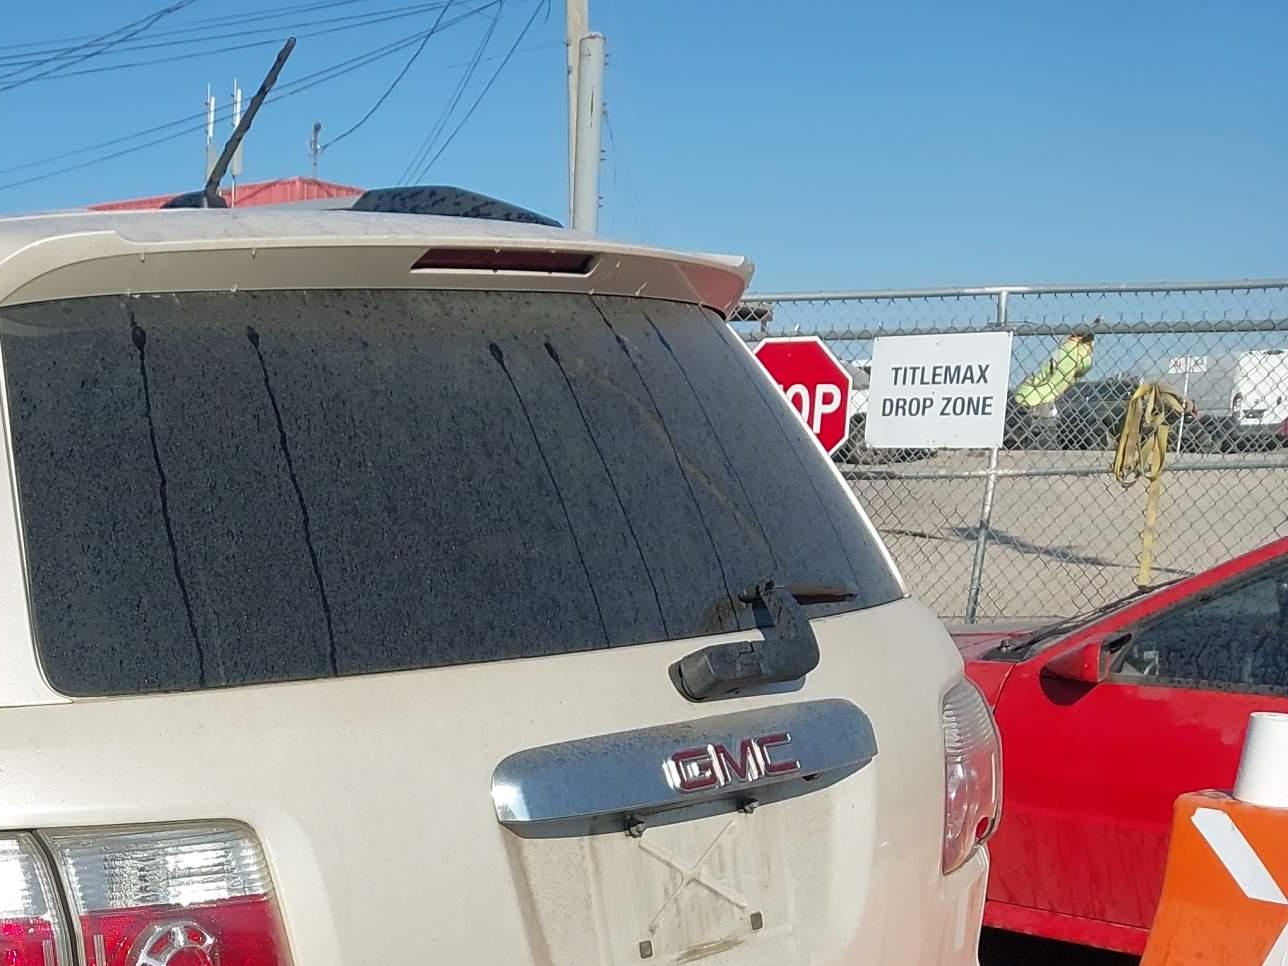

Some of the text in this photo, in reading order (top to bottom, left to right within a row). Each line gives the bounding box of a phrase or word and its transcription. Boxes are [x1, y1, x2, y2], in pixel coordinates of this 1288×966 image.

[891, 364, 990, 386] TITLEMAX
[778, 383, 842, 434] OP
[881, 396, 994, 417] DROP ZONE
[662, 731, 800, 794] GMC
